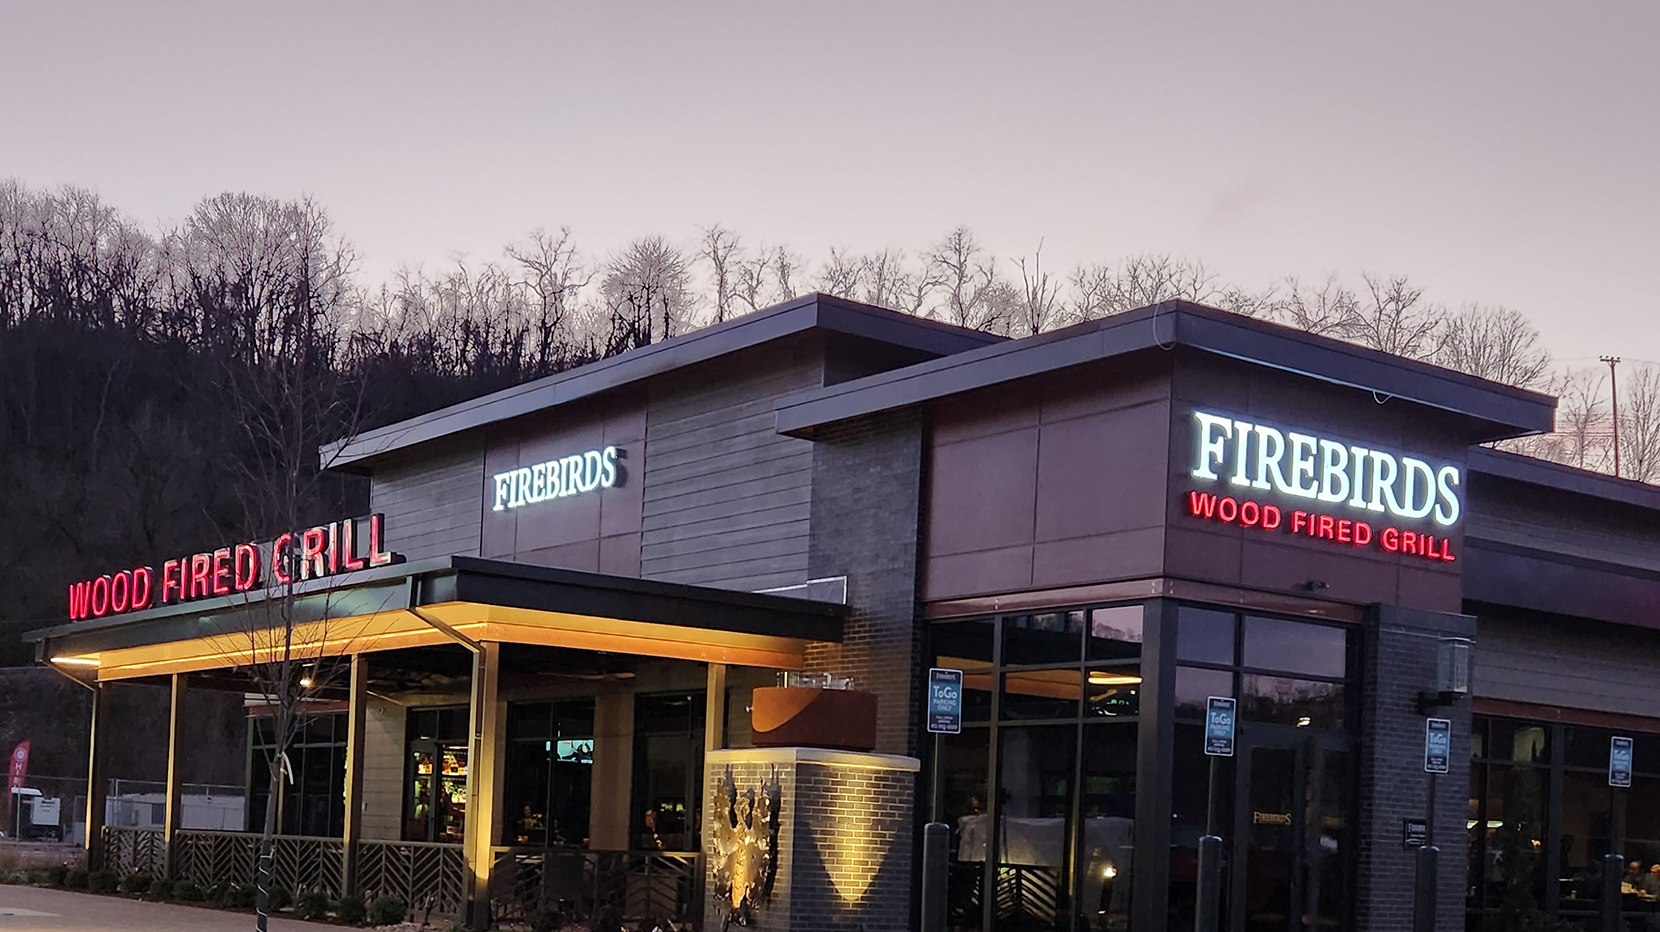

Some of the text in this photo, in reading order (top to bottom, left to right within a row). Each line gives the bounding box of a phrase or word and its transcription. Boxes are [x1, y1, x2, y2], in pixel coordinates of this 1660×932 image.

[493, 446, 618, 511] FIREBIRDS
[1192, 411, 1460, 526] FIREBIRDS
[1190, 491, 1456, 562] WOOD FIRED GRILL
[69, 513, 391, 620] WOOD FIRED GRILL
[13, 763, 22, 787] HIR
